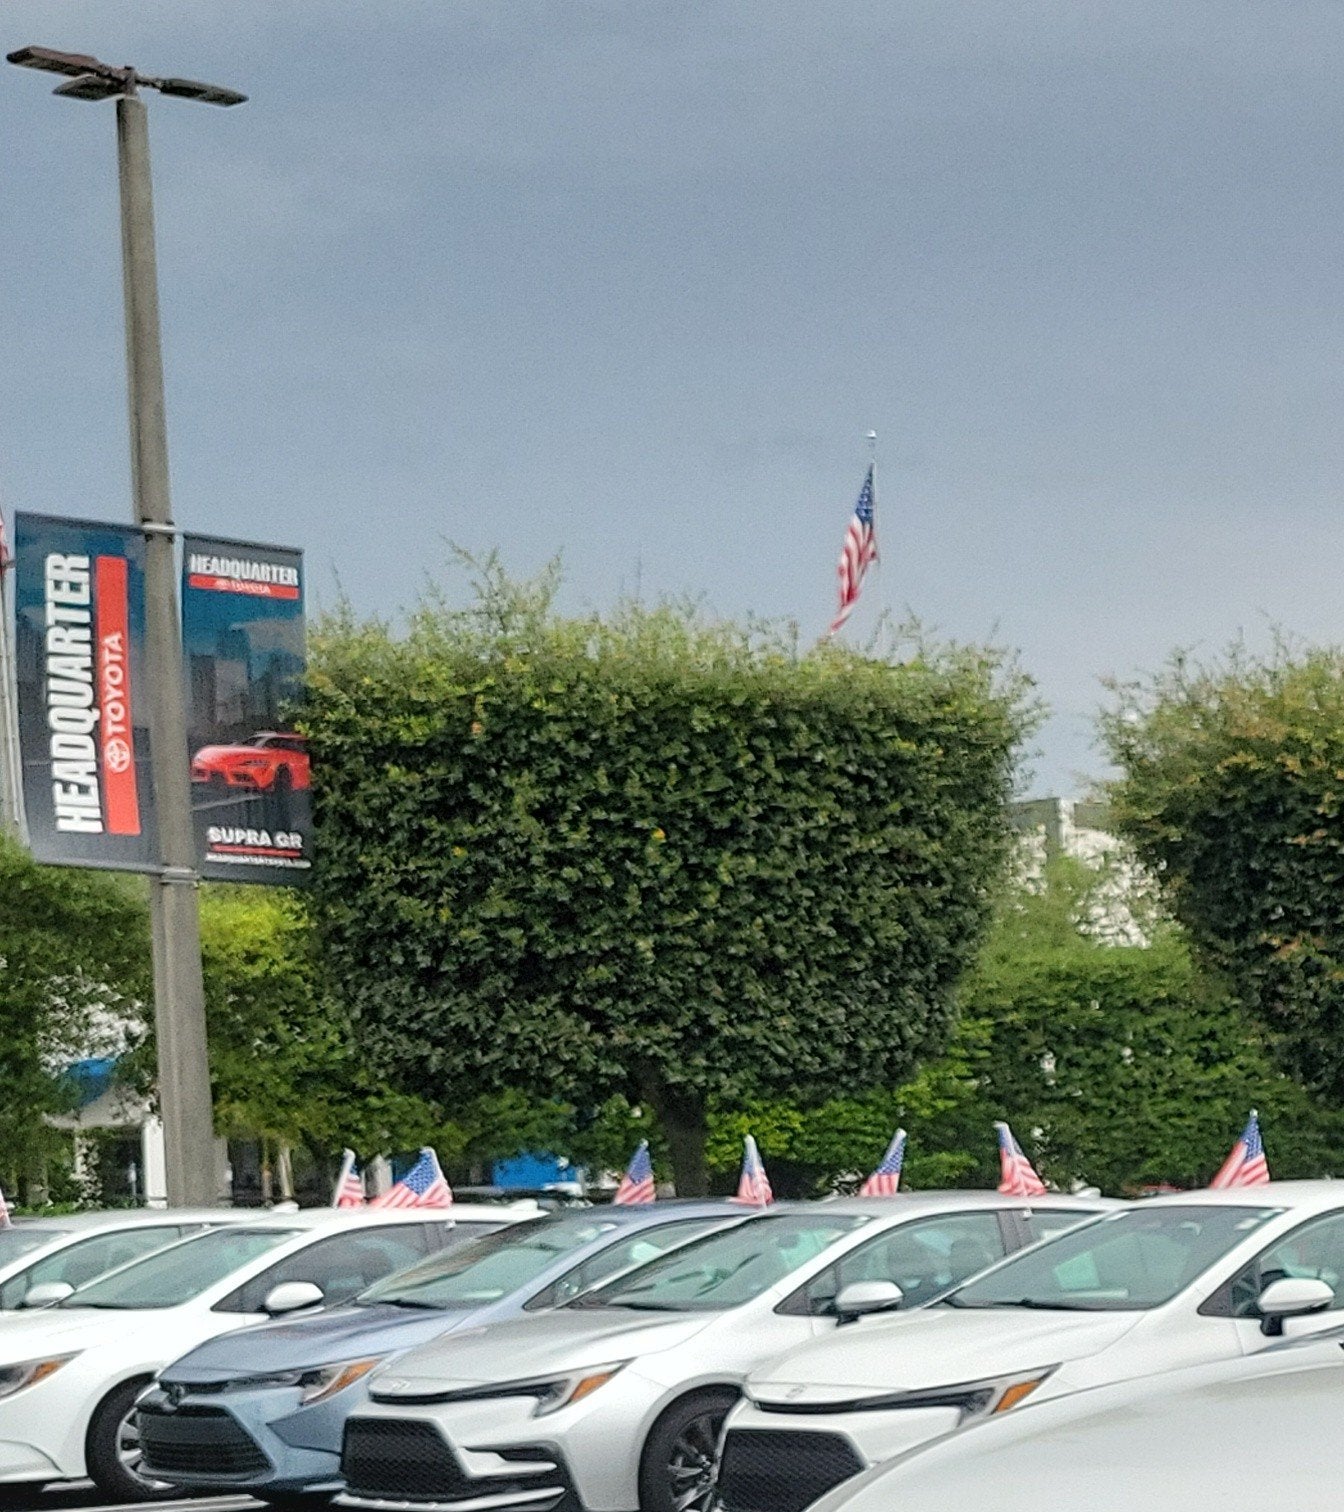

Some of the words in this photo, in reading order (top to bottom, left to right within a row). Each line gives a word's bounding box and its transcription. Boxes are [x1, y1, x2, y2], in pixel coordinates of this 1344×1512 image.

[189, 553, 299, 586] HEADQUARTER
[45, 553, 103, 833] HEADQUARTER
[103, 632, 125, 737] TOYOTA
[207, 826, 273, 847] SUPRA
[273, 831, 304, 850] GR
